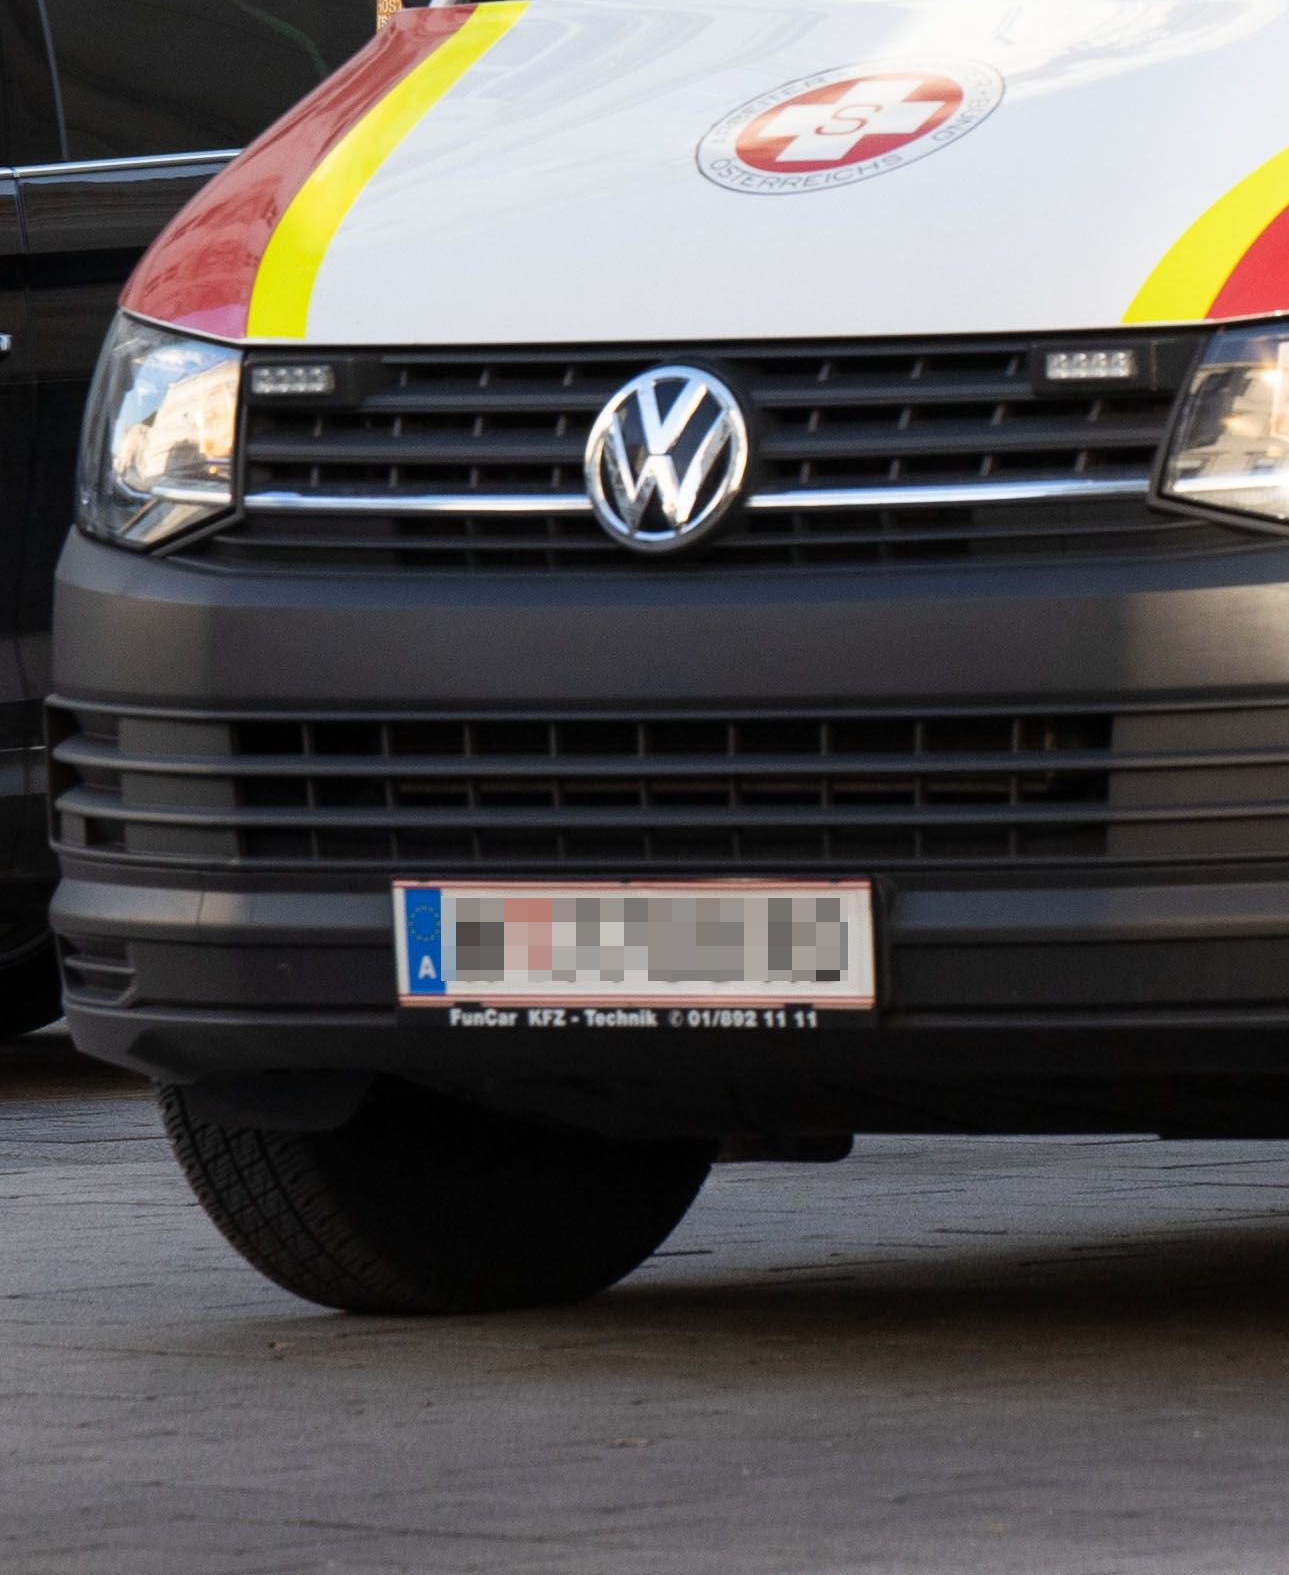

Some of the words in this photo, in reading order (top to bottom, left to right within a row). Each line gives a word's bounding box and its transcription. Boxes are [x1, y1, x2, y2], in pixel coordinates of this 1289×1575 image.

[814, 103, 883, 137] S
[417, 954, 438, 980] A
[449, 1008, 518, 1028] FunCar
[527, 1009, 567, 1027] KFZ
[584, 1008, 658, 1028] Technik
[687, 1009, 758, 1028] 01/892
[763, 1010, 787, 1028] 11
[793, 1010, 818, 1028] 11
